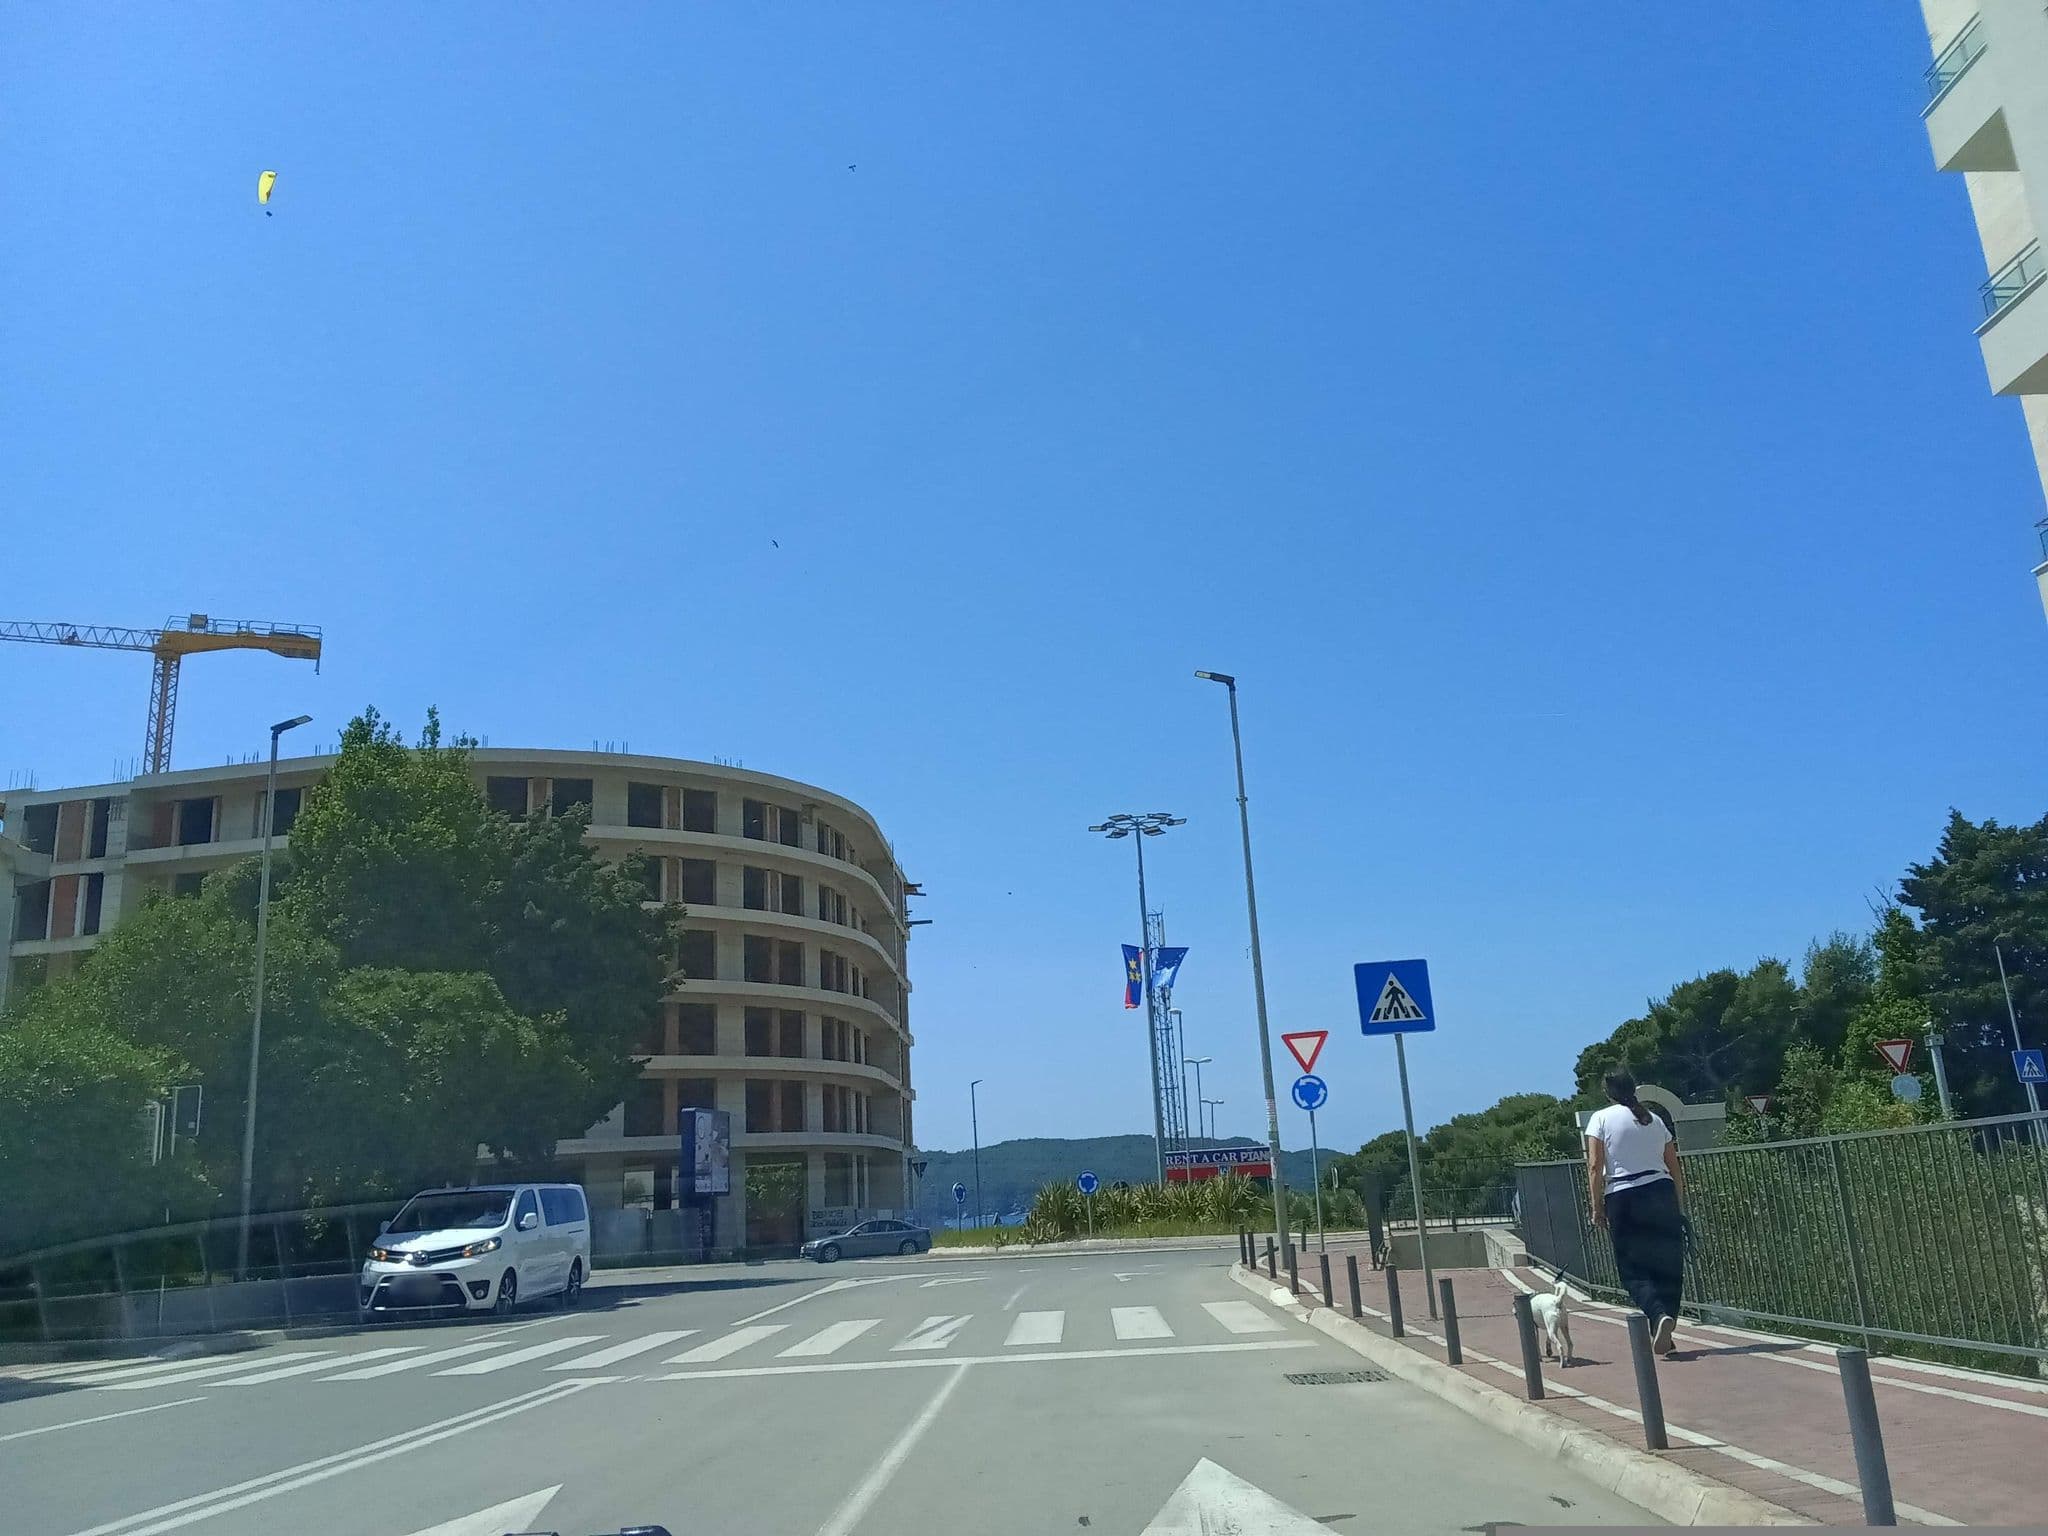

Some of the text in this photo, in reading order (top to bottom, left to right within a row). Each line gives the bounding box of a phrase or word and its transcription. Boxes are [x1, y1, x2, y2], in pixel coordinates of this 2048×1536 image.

[1166, 1154, 1199, 1165] RENT
[1202, 1154, 1210, 1163] A
[1212, 1152, 1237, 1163] CAR
